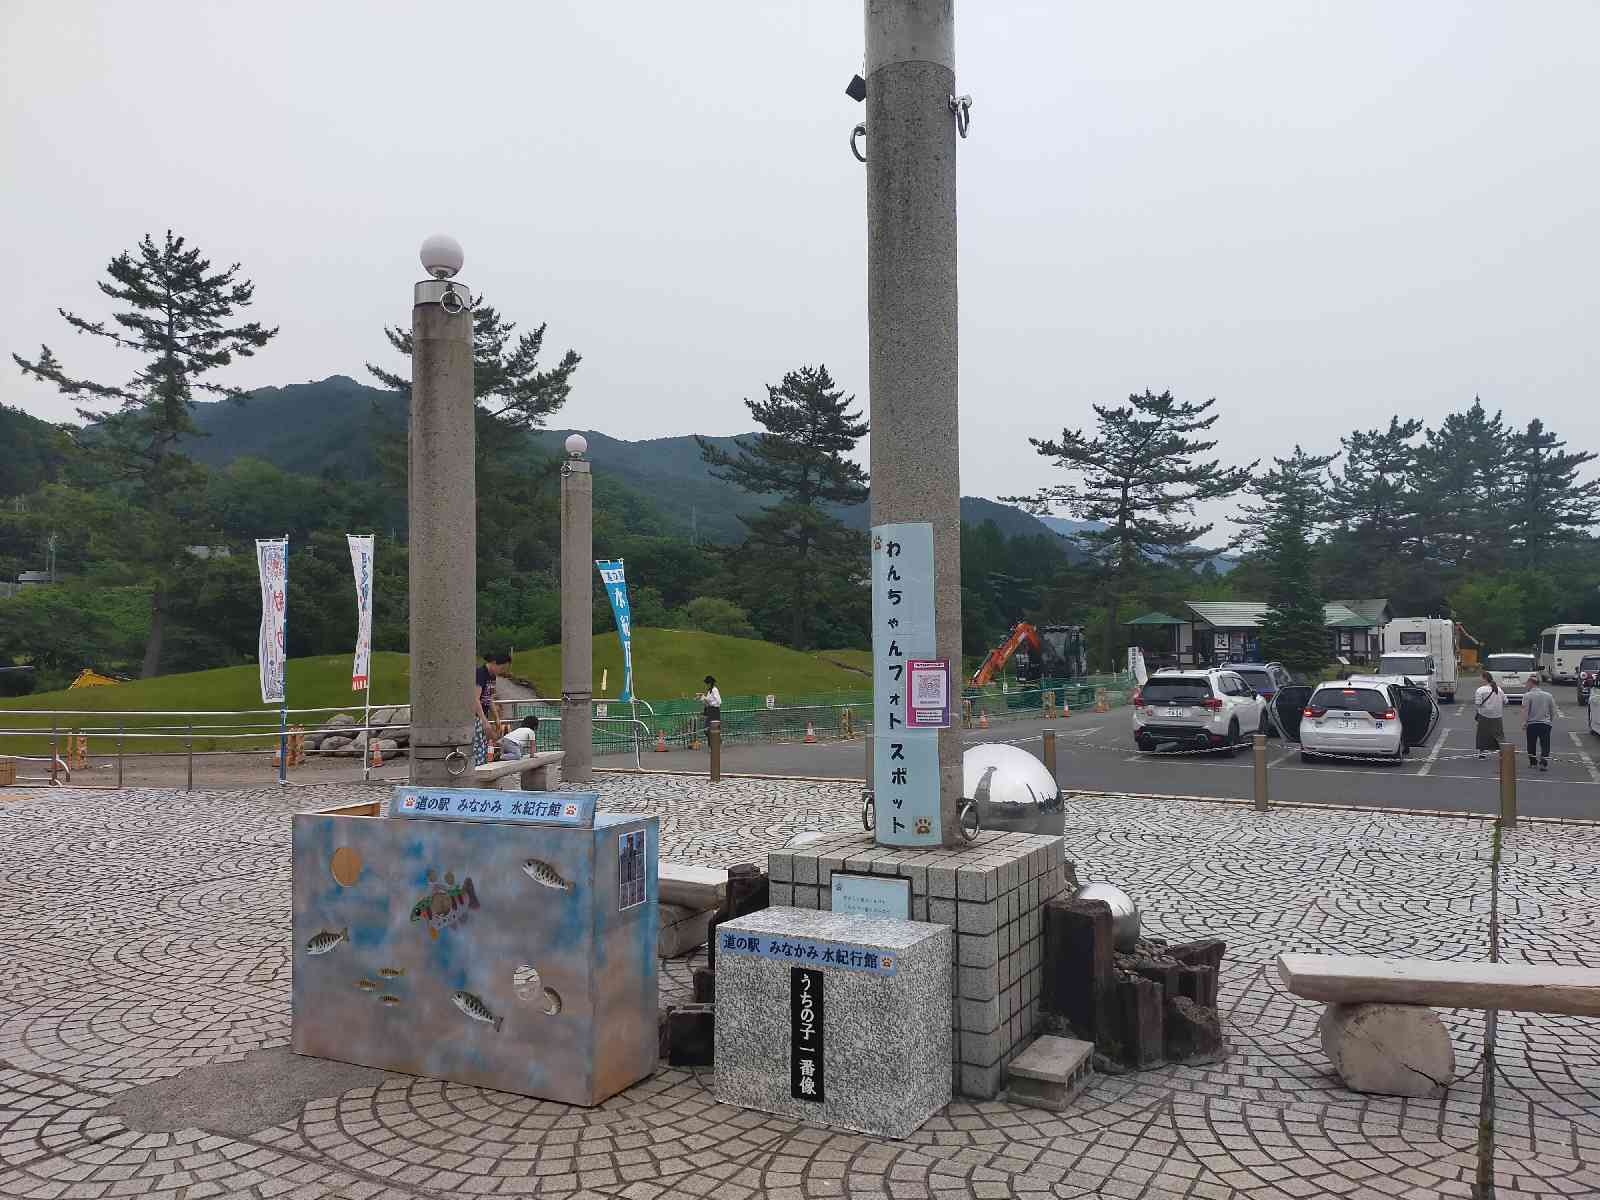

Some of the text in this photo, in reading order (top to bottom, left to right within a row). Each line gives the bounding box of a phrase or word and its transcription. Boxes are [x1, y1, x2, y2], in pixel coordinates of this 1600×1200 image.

[415, 795, 562, 817] 道の駅 みなかみ 水紀行館
[723, 933, 879, 969] 道の駅 みなかみ 水紀行館
[799, 973, 817, 1095] うちの子一番像
